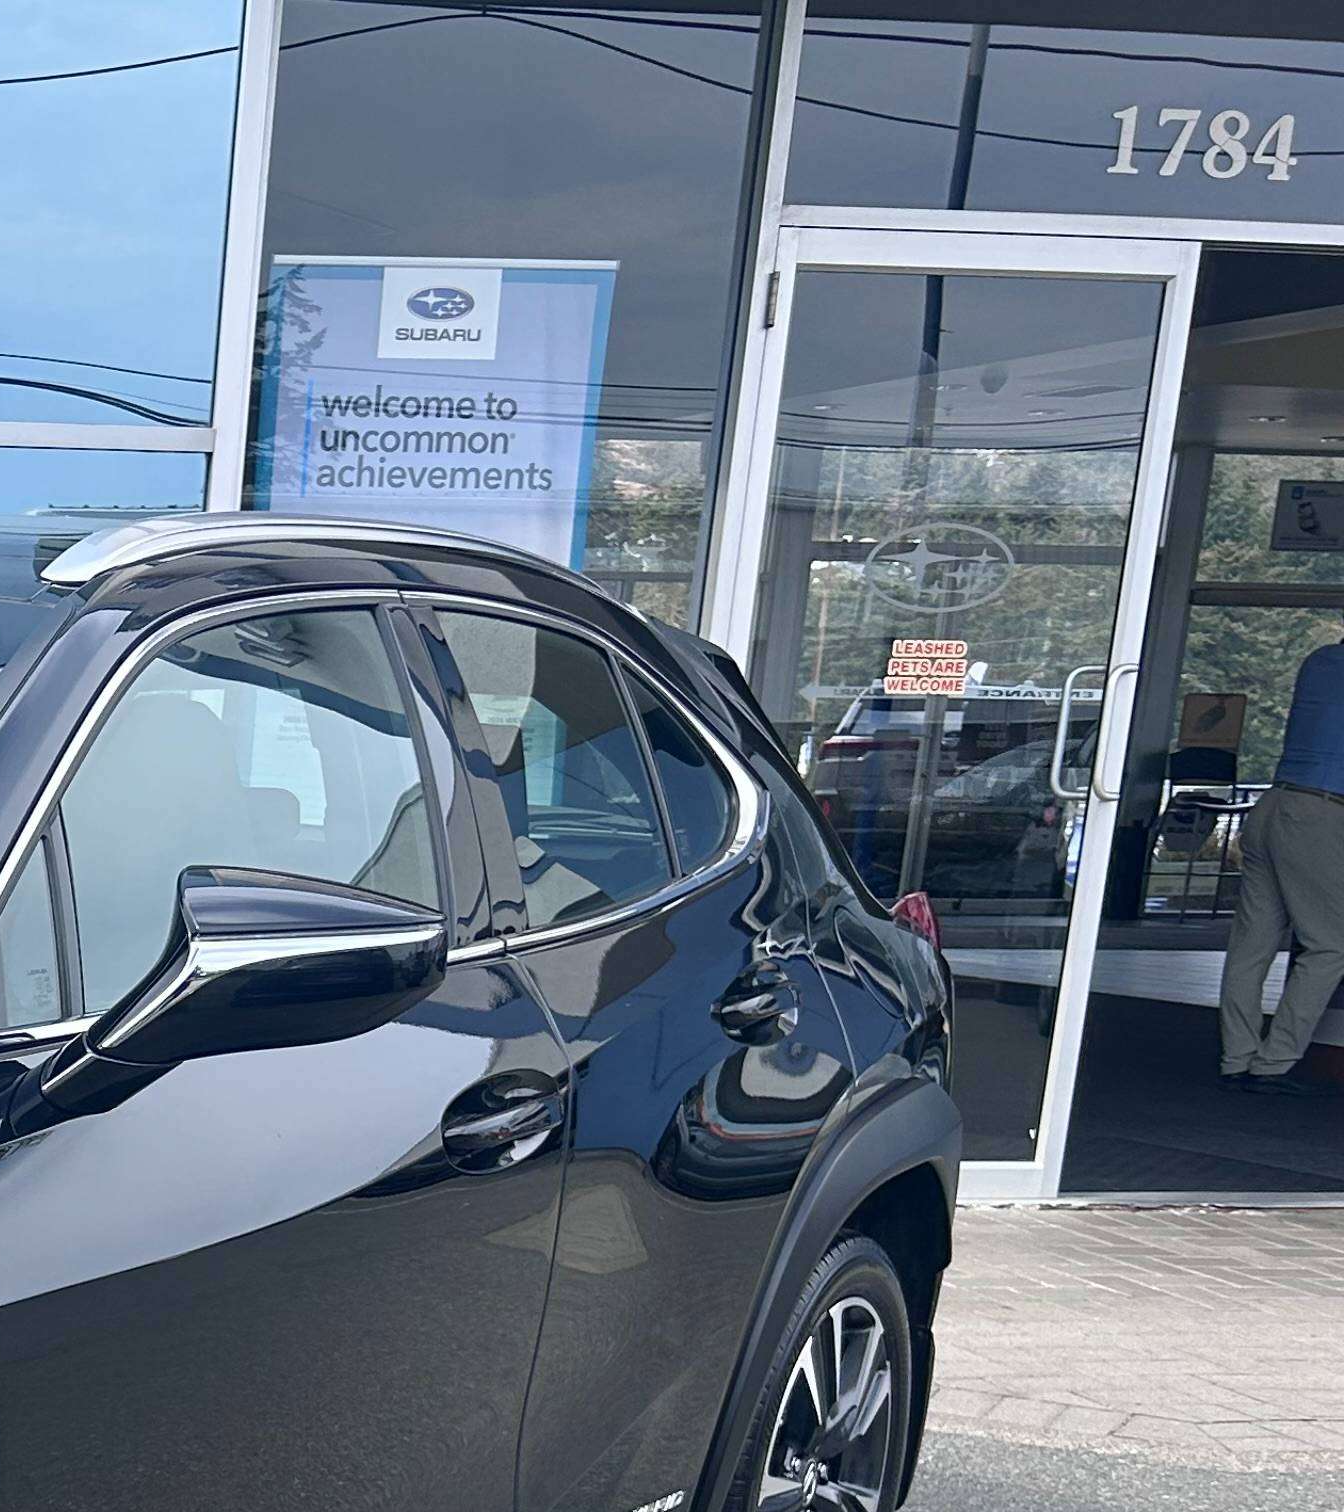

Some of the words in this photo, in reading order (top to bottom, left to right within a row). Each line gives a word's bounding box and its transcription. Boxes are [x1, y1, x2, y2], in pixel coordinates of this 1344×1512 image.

[1106, 105, 1298, 181] 1784
[395, 327, 482, 342] SUBARU
[320, 385, 474, 419] welcome
[484, 391, 518, 420] to
[320, 426, 512, 454] uncommon
[315, 455, 553, 490] achievements
[895, 642, 965, 655] LEASHED
[891, 661, 929, 673] PETS
[931, 662, 965, 674] ARE
[886, 679, 964, 692] WELCOME
